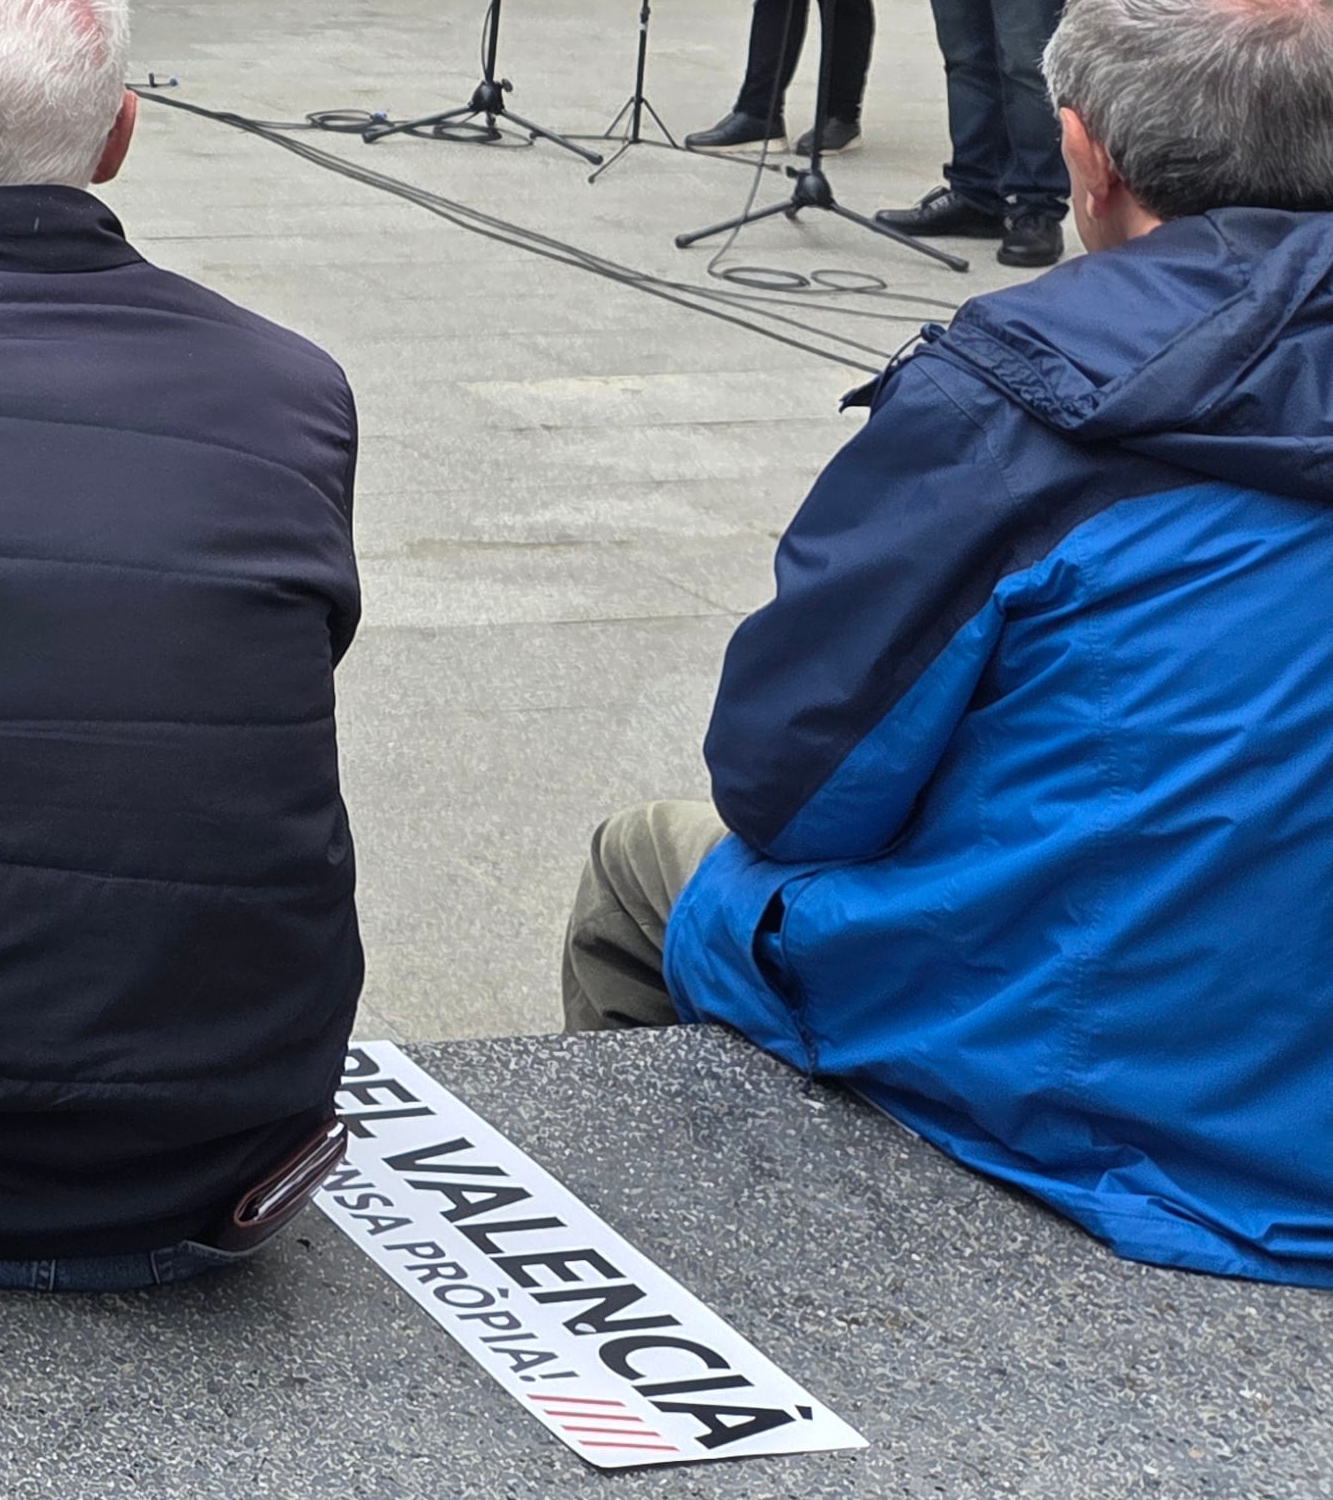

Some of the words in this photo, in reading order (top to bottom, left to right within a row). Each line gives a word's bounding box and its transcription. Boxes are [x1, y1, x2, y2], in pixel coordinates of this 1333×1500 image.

[322, 1155, 414, 1236] NSA
[383, 1241, 580, 1382] PRÒPIA!
[381, 1136, 814, 1450] VALENCIÀ
